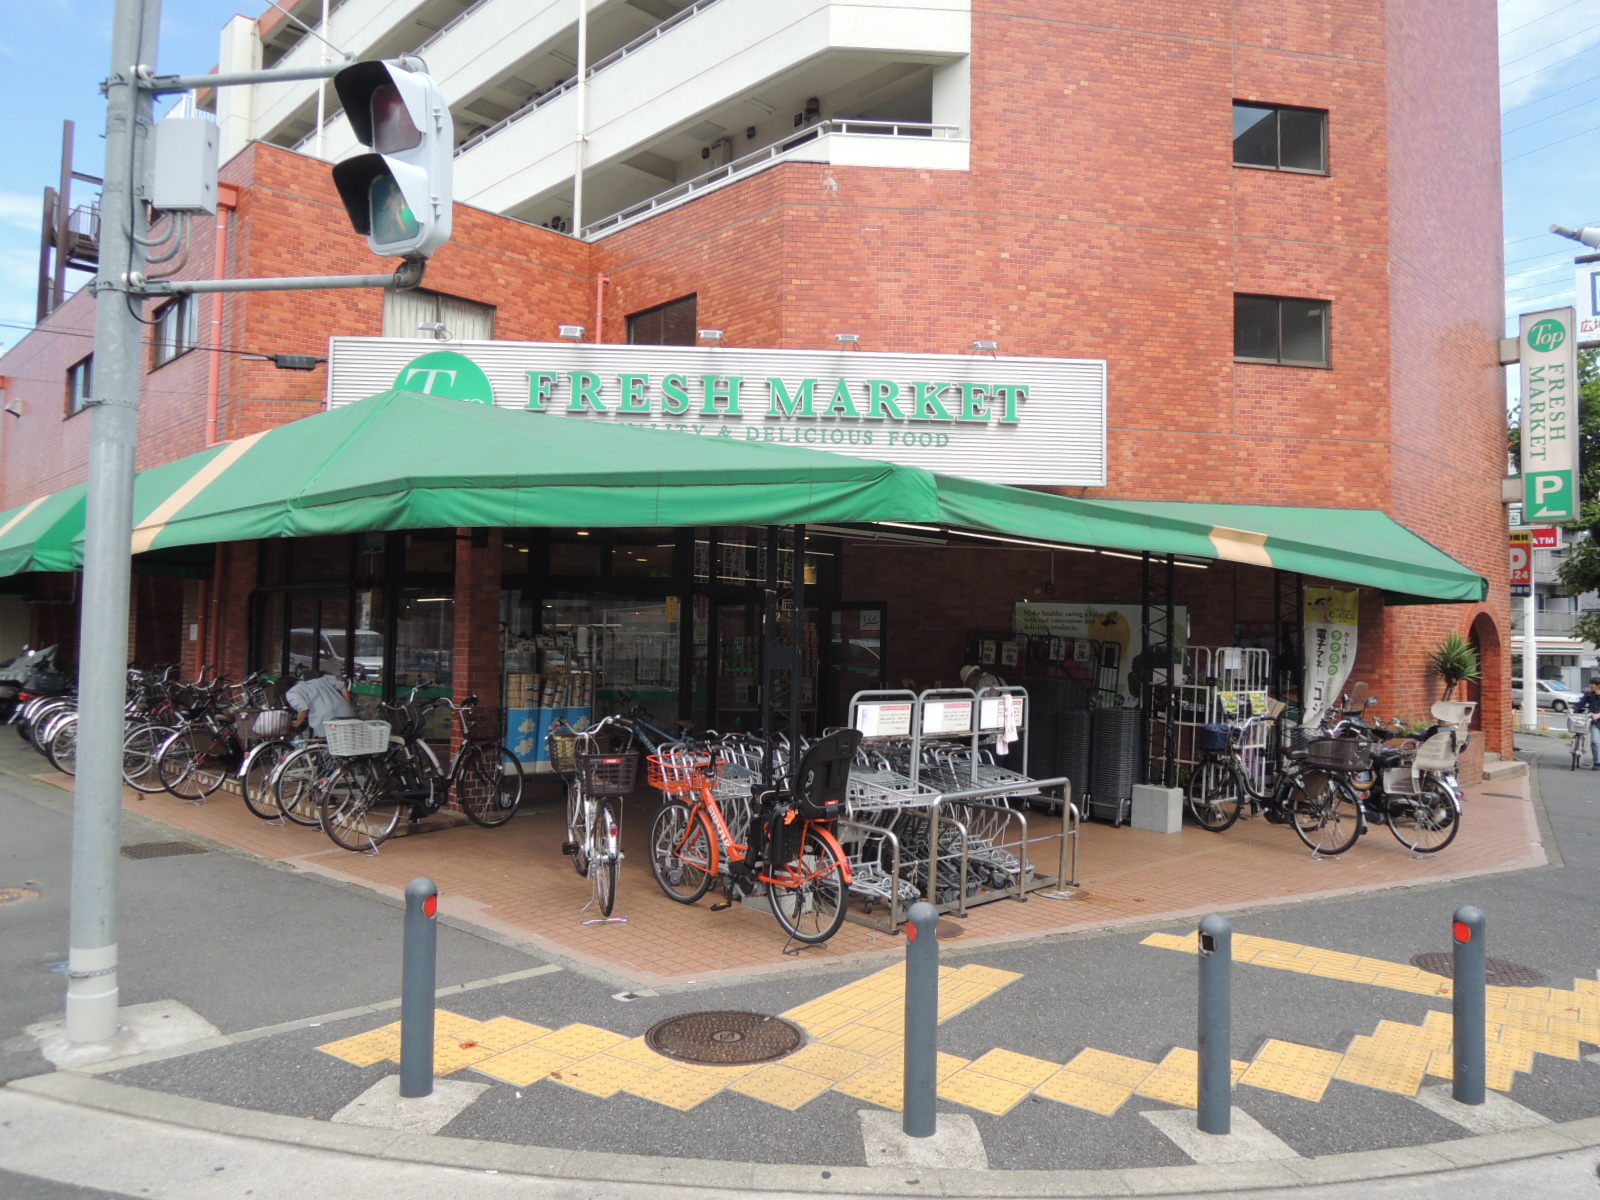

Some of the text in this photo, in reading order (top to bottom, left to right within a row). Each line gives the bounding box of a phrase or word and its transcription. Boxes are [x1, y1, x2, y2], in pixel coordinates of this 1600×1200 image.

[1531, 324, 1564, 350] Top
[523, 370, 745, 415] FRESH
[764, 377, 1030, 423] MARKET
[1549, 363, 1566, 441] FRESH
[1529, 365, 1546, 461] MARKET
[719, 425, 732, 438] &
[746, 426, 874, 445] DELICIOUS
[888, 431, 951, 447] FOOD
[1535, 475, 1564, 504] P
[1510, 548, 1528, 579] P
[1513, 570, 1529, 579] 24
